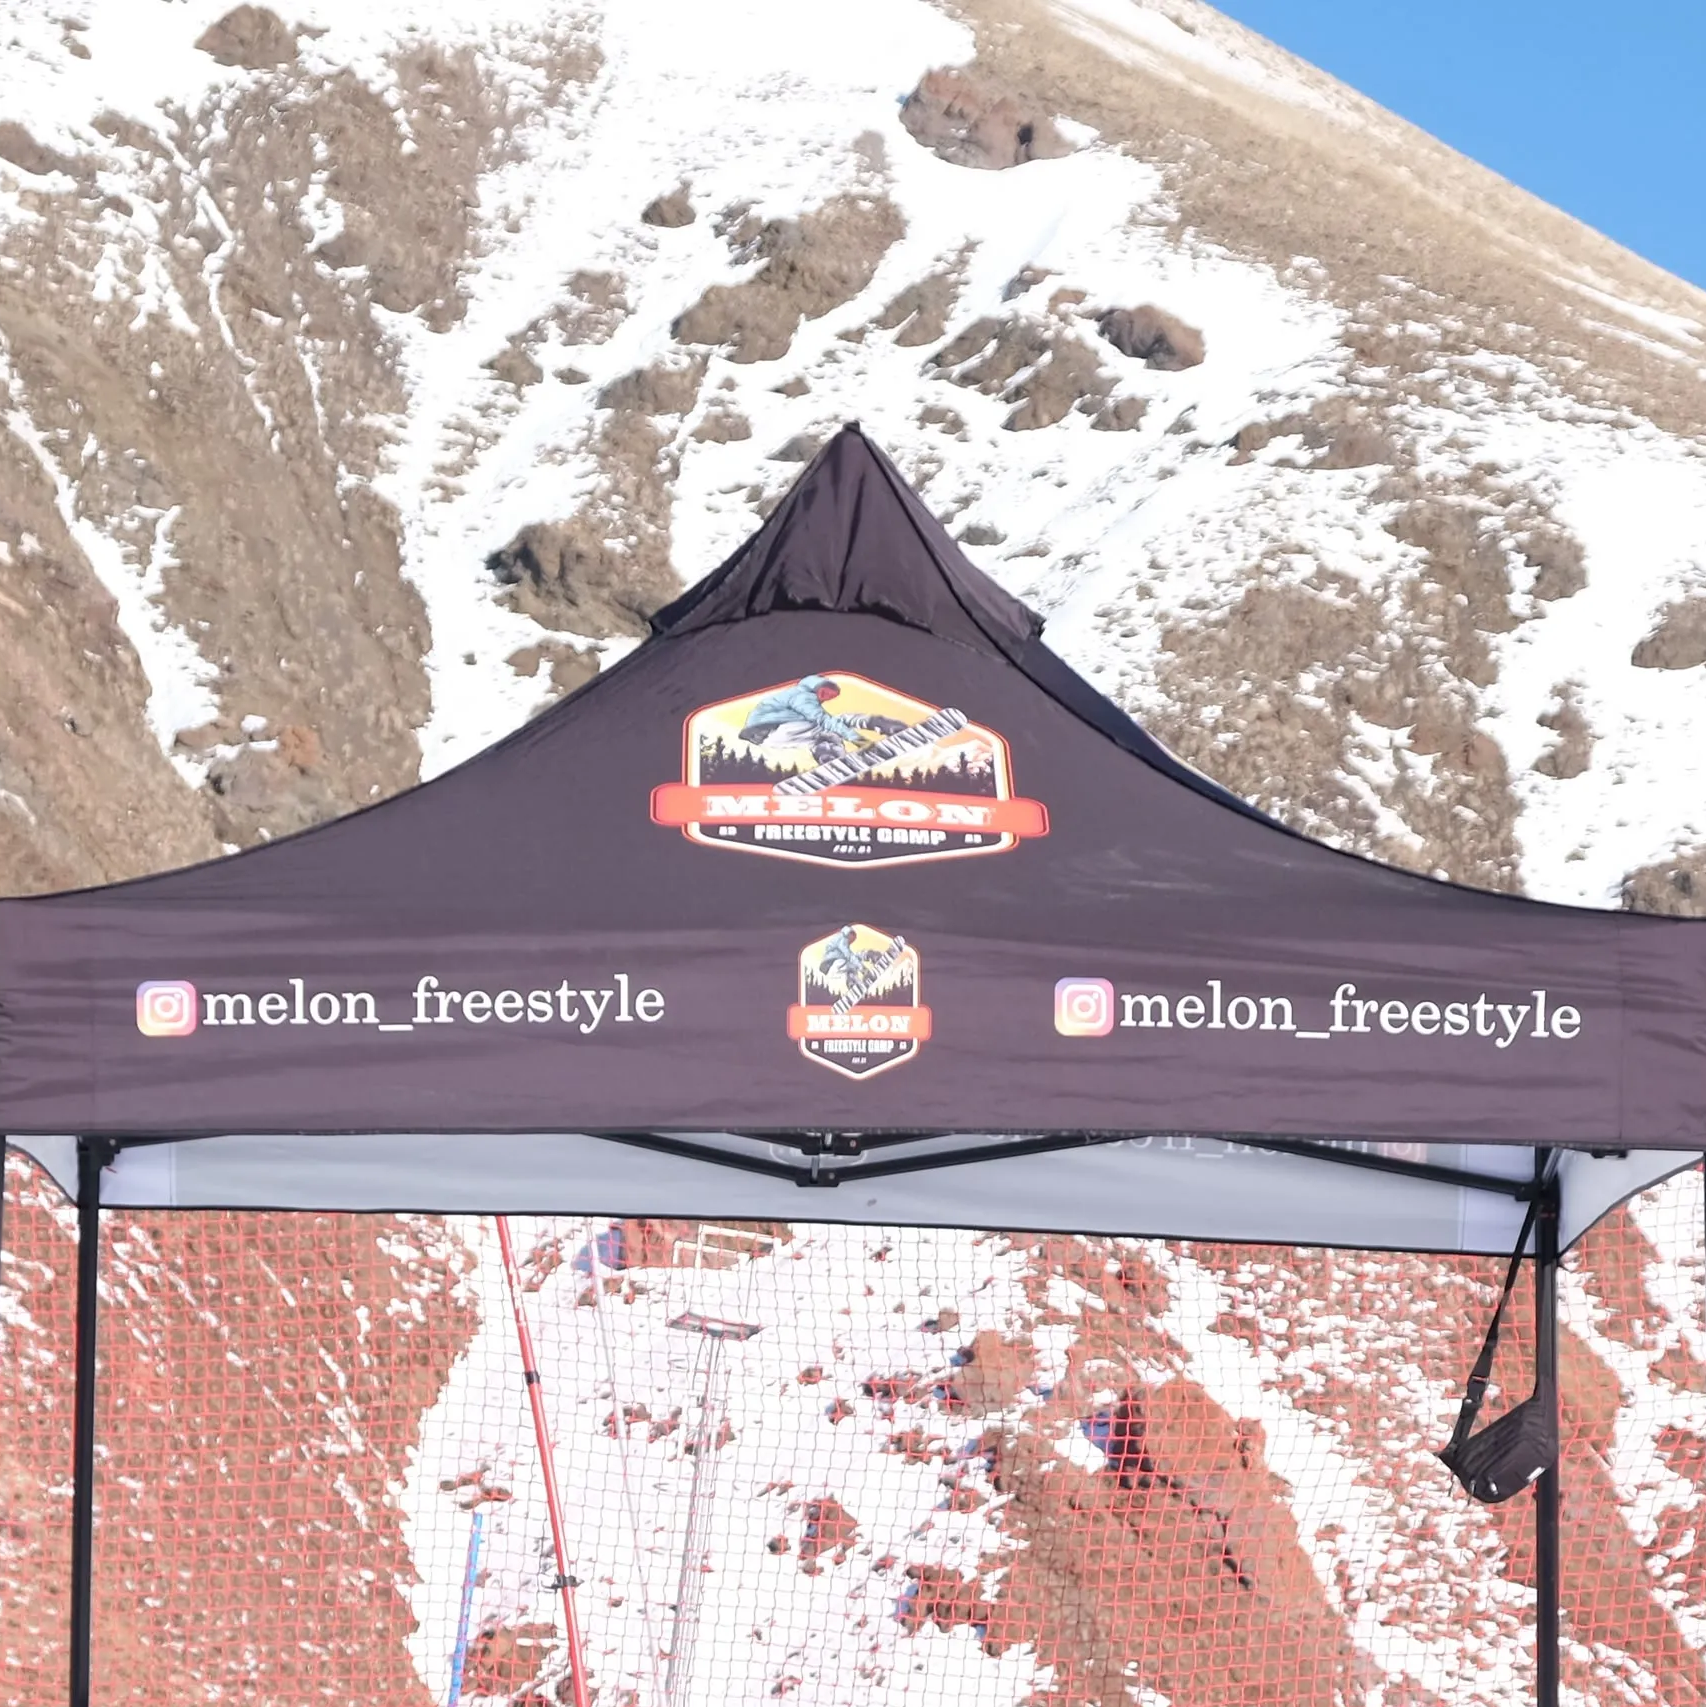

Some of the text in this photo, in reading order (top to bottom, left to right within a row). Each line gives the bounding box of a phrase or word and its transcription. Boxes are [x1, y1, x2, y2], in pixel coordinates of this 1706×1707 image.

[704, 794, 995, 825] MELON
[754, 824, 871, 842] FREESTYLE
[877, 827, 946, 845] CAMP
[202, 974, 665, 1034] melon_freestyle
[1120, 980, 1581, 1049] melon_freestyle
[806, 1014, 910, 1033] MELON
